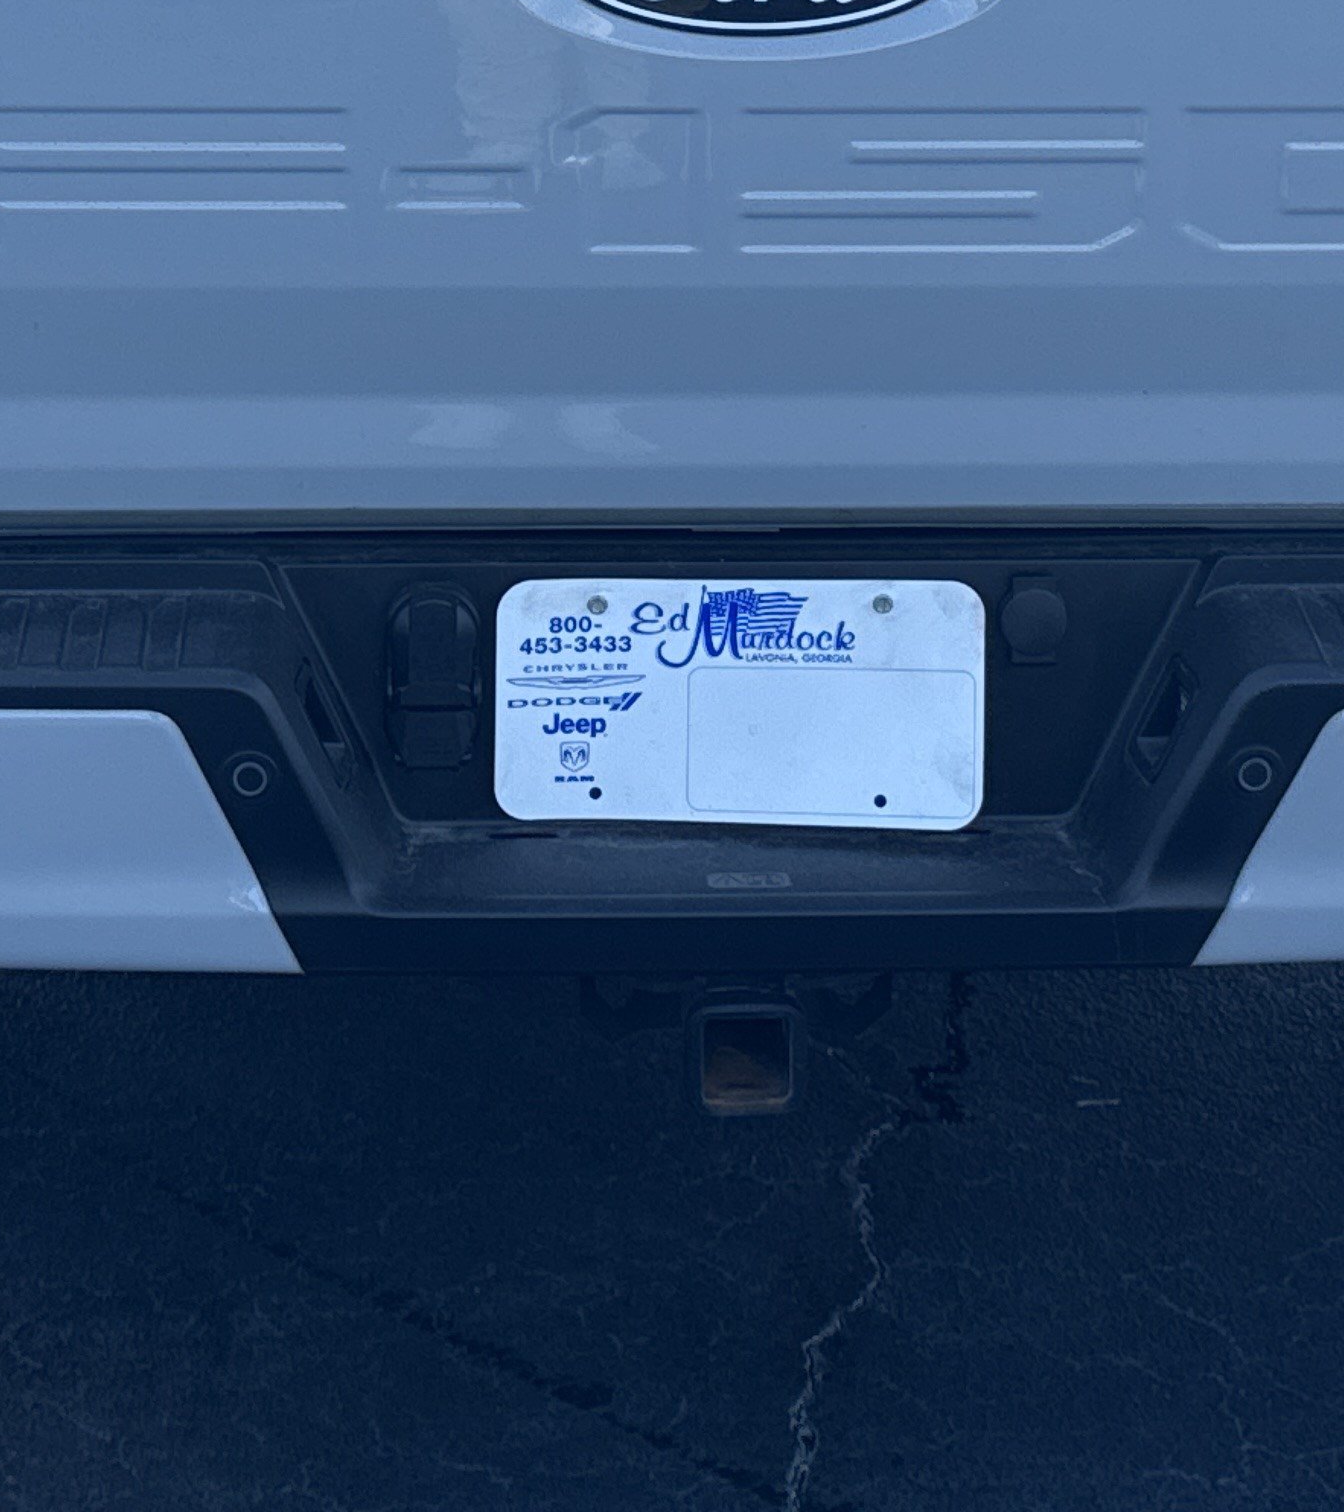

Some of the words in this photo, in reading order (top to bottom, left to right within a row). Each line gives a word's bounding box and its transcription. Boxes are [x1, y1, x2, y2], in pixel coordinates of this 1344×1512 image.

[549, 616, 603, 633] 800-
[629, 601, 690, 635] Ed
[657, 585, 856, 668] Murdock
[519, 636, 632, 655] 453-3433
[801, 653, 853, 664] GEORGIA
[523, 663, 629, 673] CHRYSLER
[507, 696, 624, 709] DODGE
[542, 713, 607, 737] Jeep
[554, 775, 595, 783] RAM
